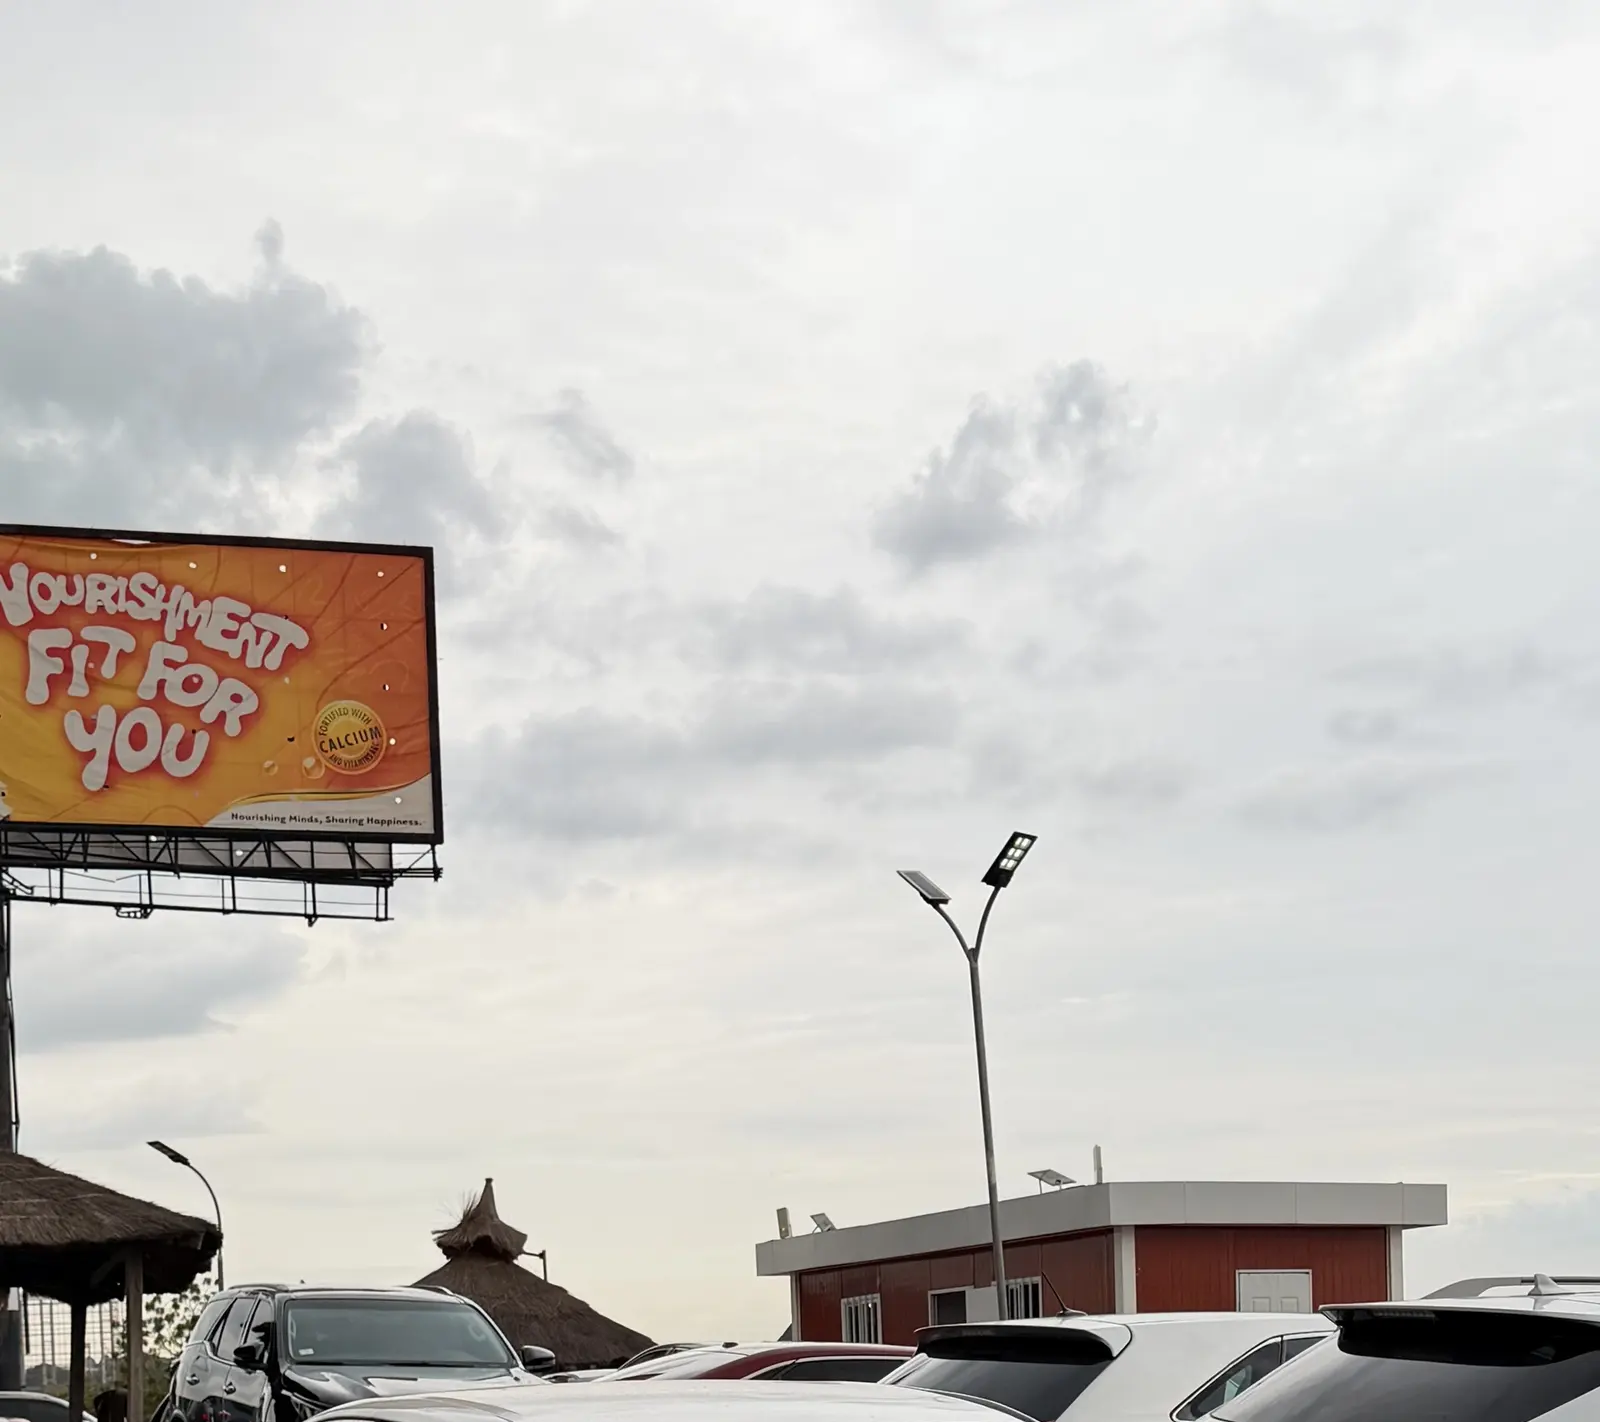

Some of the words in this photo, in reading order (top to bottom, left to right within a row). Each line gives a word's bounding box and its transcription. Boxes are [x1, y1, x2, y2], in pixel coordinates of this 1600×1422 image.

[0, 562, 310, 671] NOURISHMENT
[25, 626, 136, 705] FIT
[137, 641, 259, 737] FOR
[64, 705, 210, 791] YOU
[318, 706, 349, 737] FORTIFIED
[351, 707, 373, 725] WITH
[319, 725, 382, 753] CALCIUM
[231, 812, 287, 824] Nourishing
[288, 814, 323, 824] Minds,
[325, 815, 364, 826] Sharing
[366, 816, 422, 827] Happiness.
